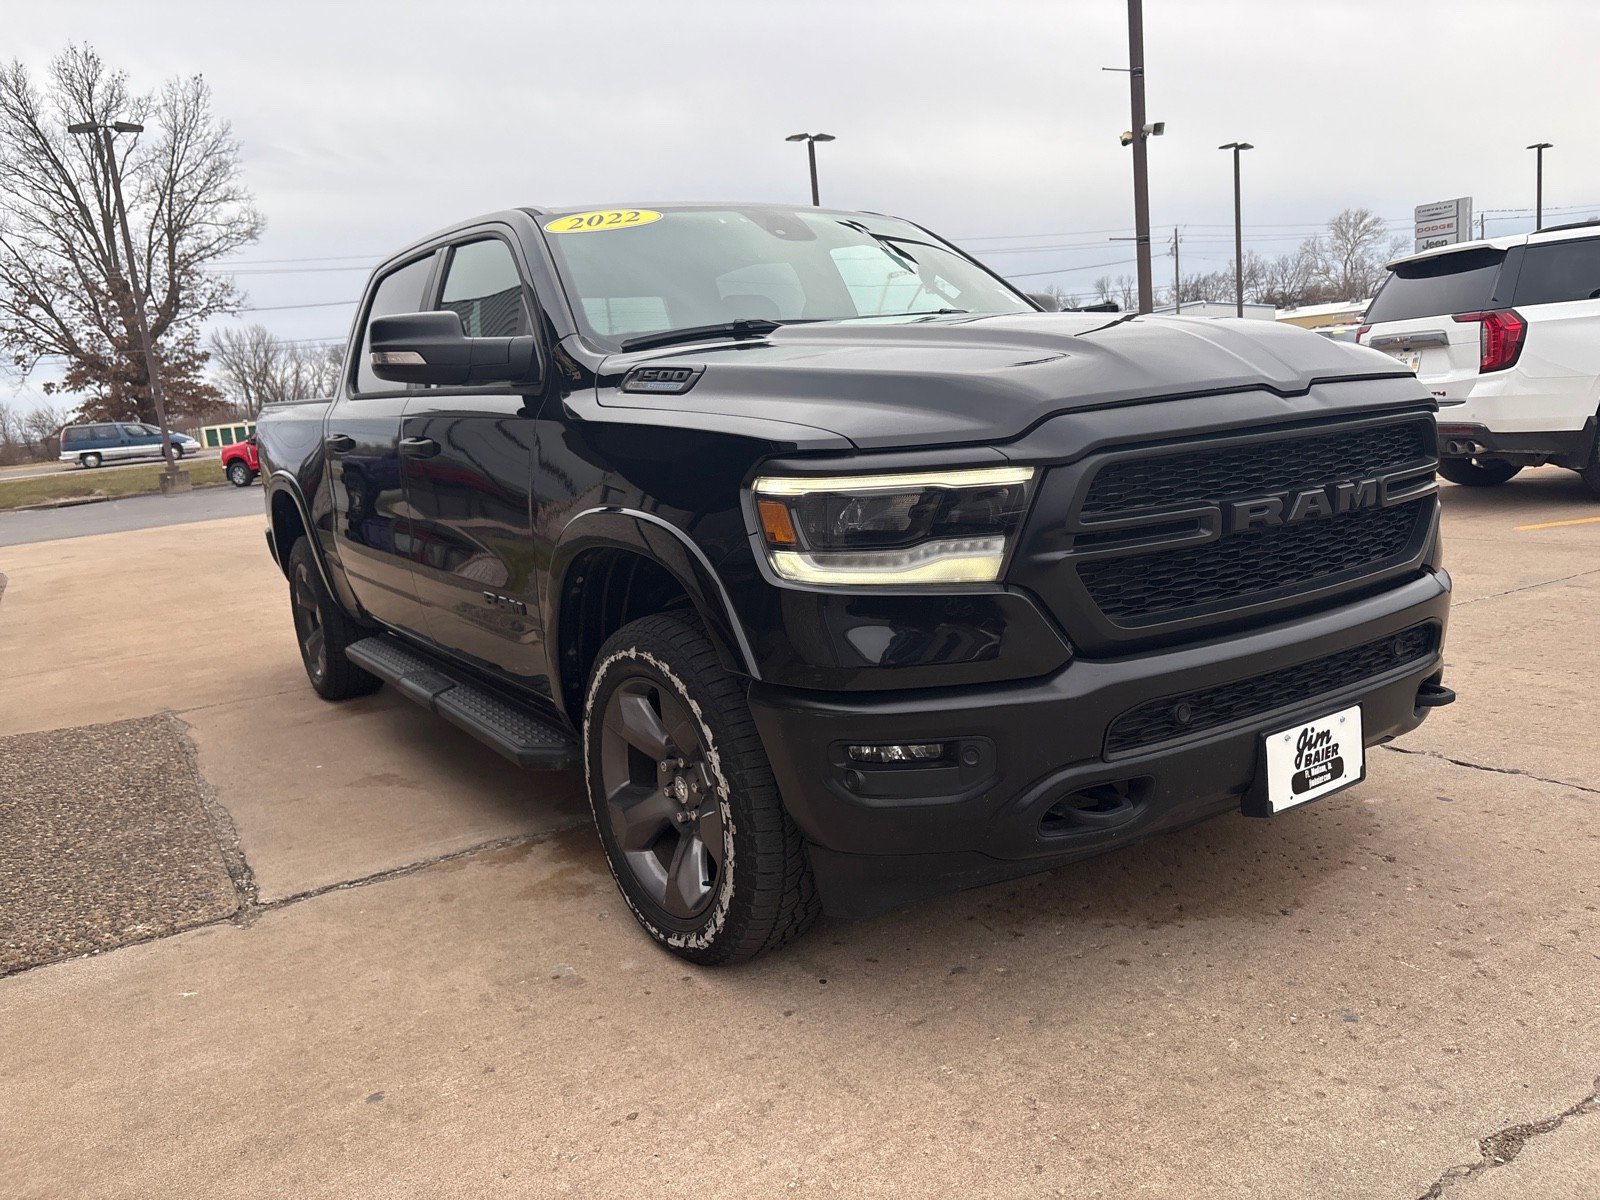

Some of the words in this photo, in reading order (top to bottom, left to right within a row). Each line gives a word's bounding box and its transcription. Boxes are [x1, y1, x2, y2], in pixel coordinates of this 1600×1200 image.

[567, 211, 640, 230] 2022
[1417, 223, 1454, 233] DODGE
[636, 369, 690, 381] 1500
[1231, 478, 1377, 534] RAM
[1294, 727, 1332, 770] Jim
[1304, 743, 1340, 768] BAIER
